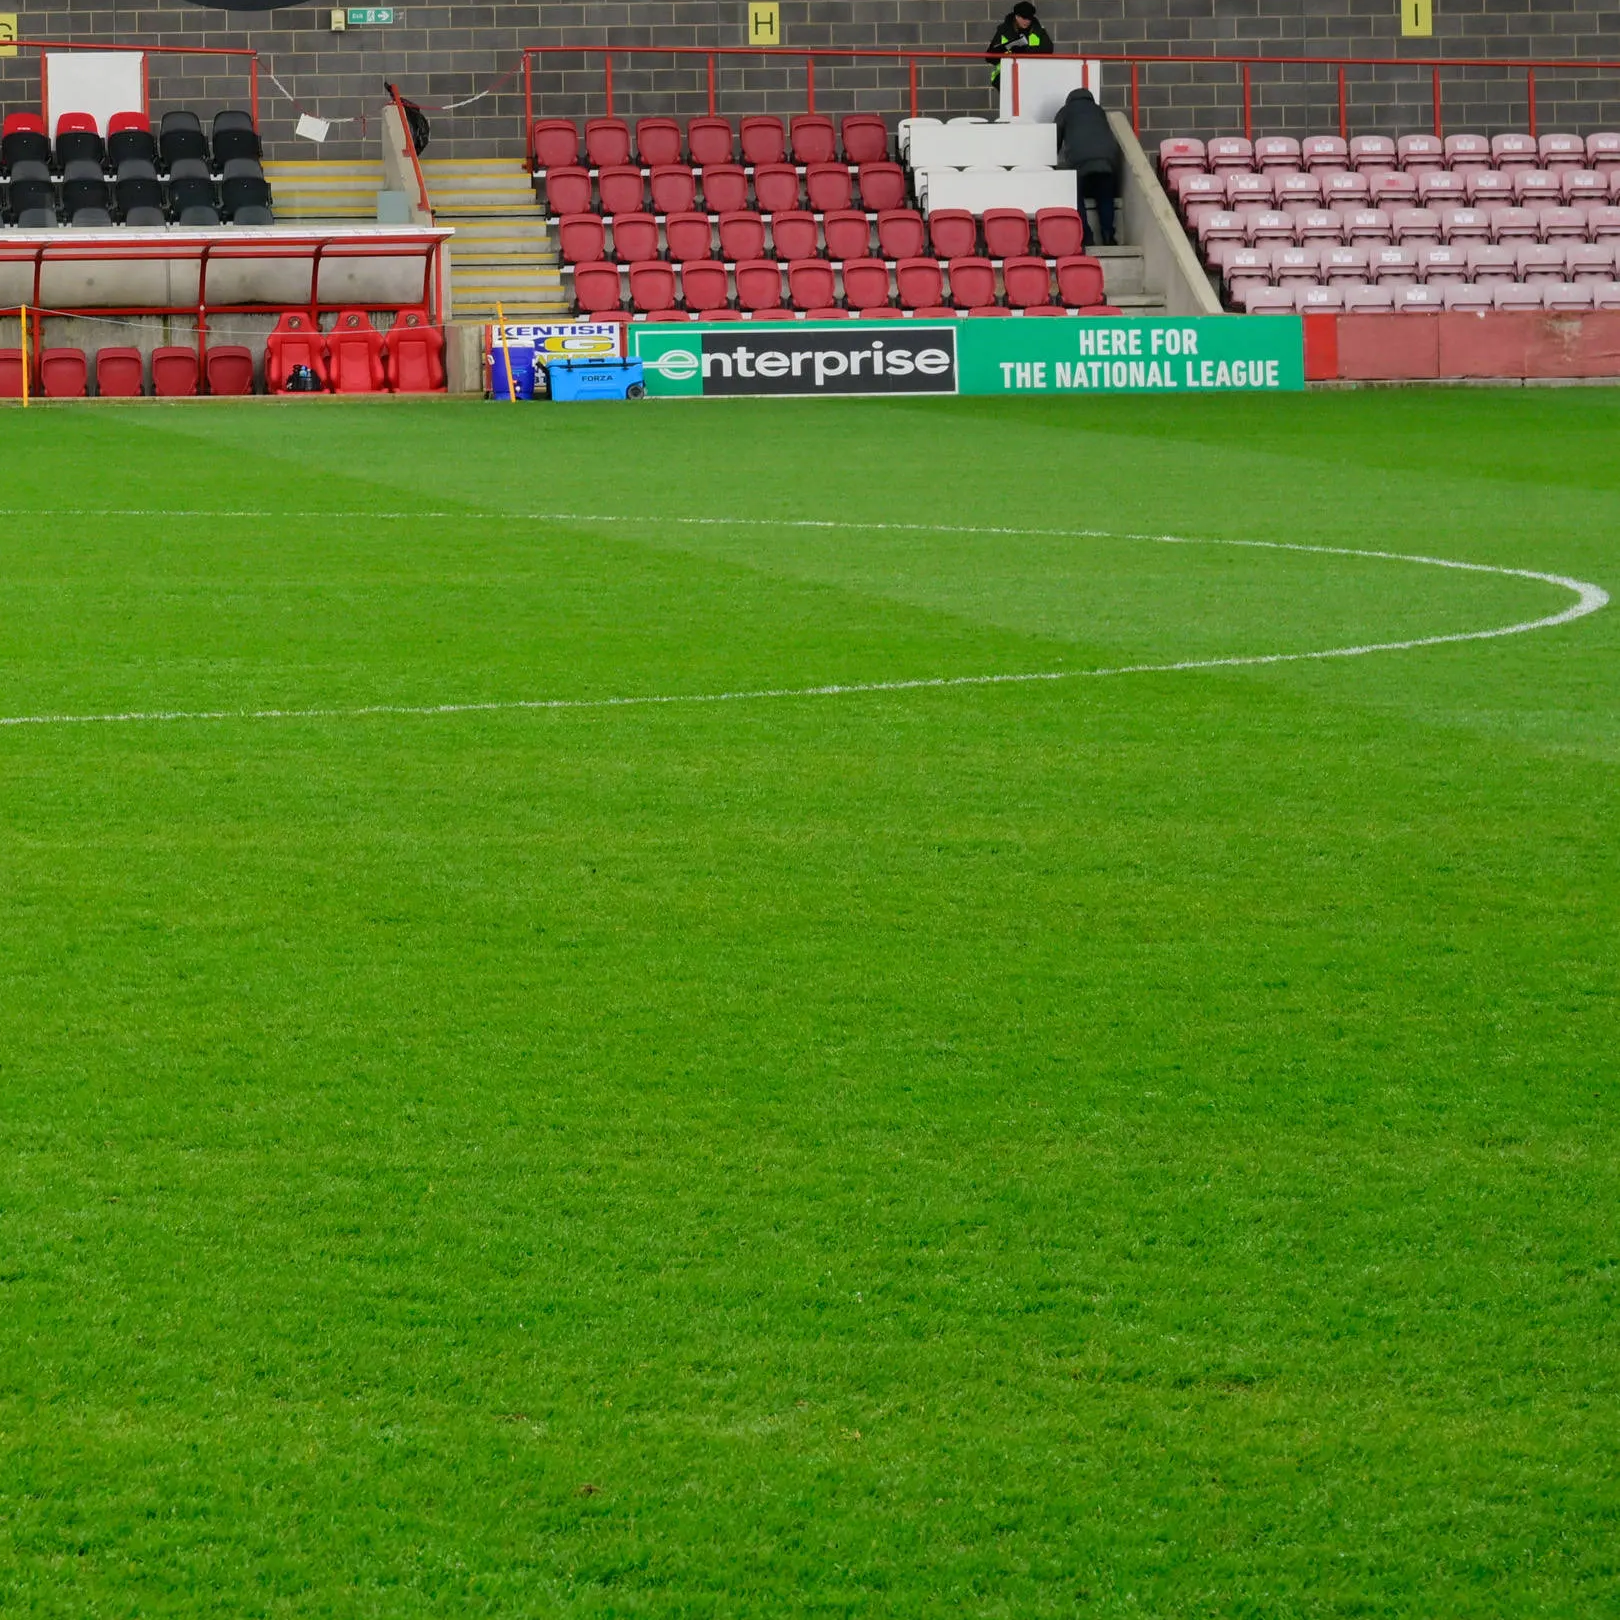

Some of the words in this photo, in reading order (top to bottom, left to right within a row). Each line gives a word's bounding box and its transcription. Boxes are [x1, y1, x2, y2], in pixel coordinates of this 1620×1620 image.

[754, 12, 773, 35] H
[1079, 329, 1142, 356] HERE
[1150, 328, 1198, 356] FOR
[658, 340, 951, 386] enterprise
[999, 361, 1047, 389] THE
[1055, 361, 1178, 389] NATIONAL
[1186, 360, 1280, 387] LEAGUE
[581, 374, 613, 382] FORZA
